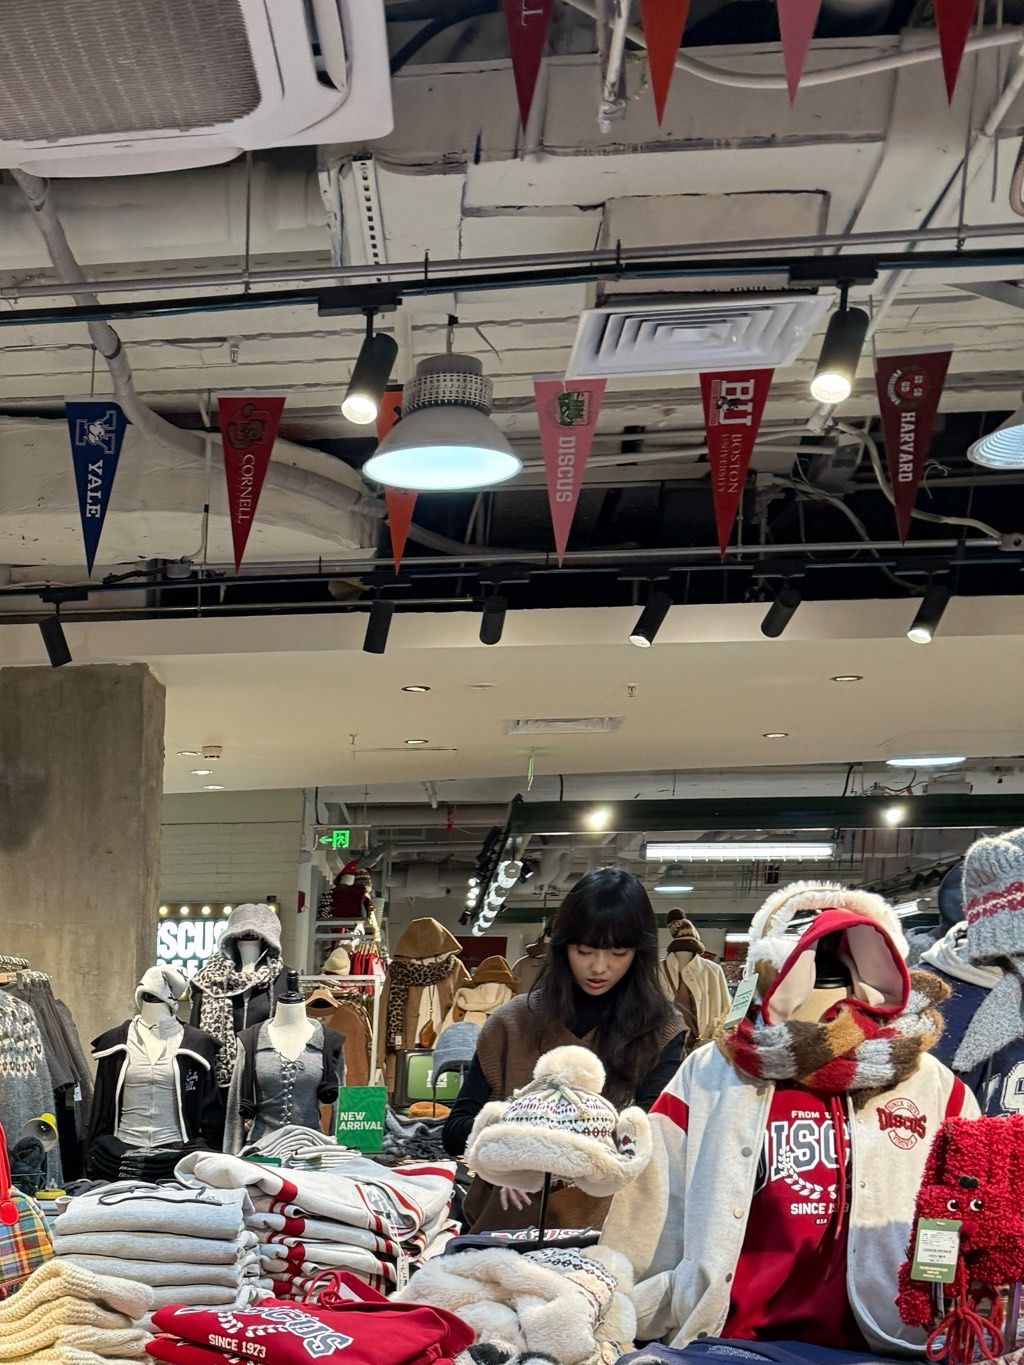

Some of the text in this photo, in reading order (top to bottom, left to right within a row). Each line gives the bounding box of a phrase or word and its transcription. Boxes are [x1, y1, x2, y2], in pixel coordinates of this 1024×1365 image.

[719, 379, 755, 426] BU
[728, 433, 743, 493] BOSTON
[898, 411, 916, 482] HARVARD
[556, 435, 576, 502] DISCUS
[86, 460, 104, 518] YALE
[238, 454, 255, 524] CORNELL
[339, 1121, 384, 1130] ARRIVAL
[340, 1112, 365, 1121] NEW
[791, 1110, 820, 1119] FROM
[876, 1107, 927, 1139] DISCUS
[790, 1203, 826, 1215] SINCE
[208, 1334, 266, 1358] SINCE 1973
